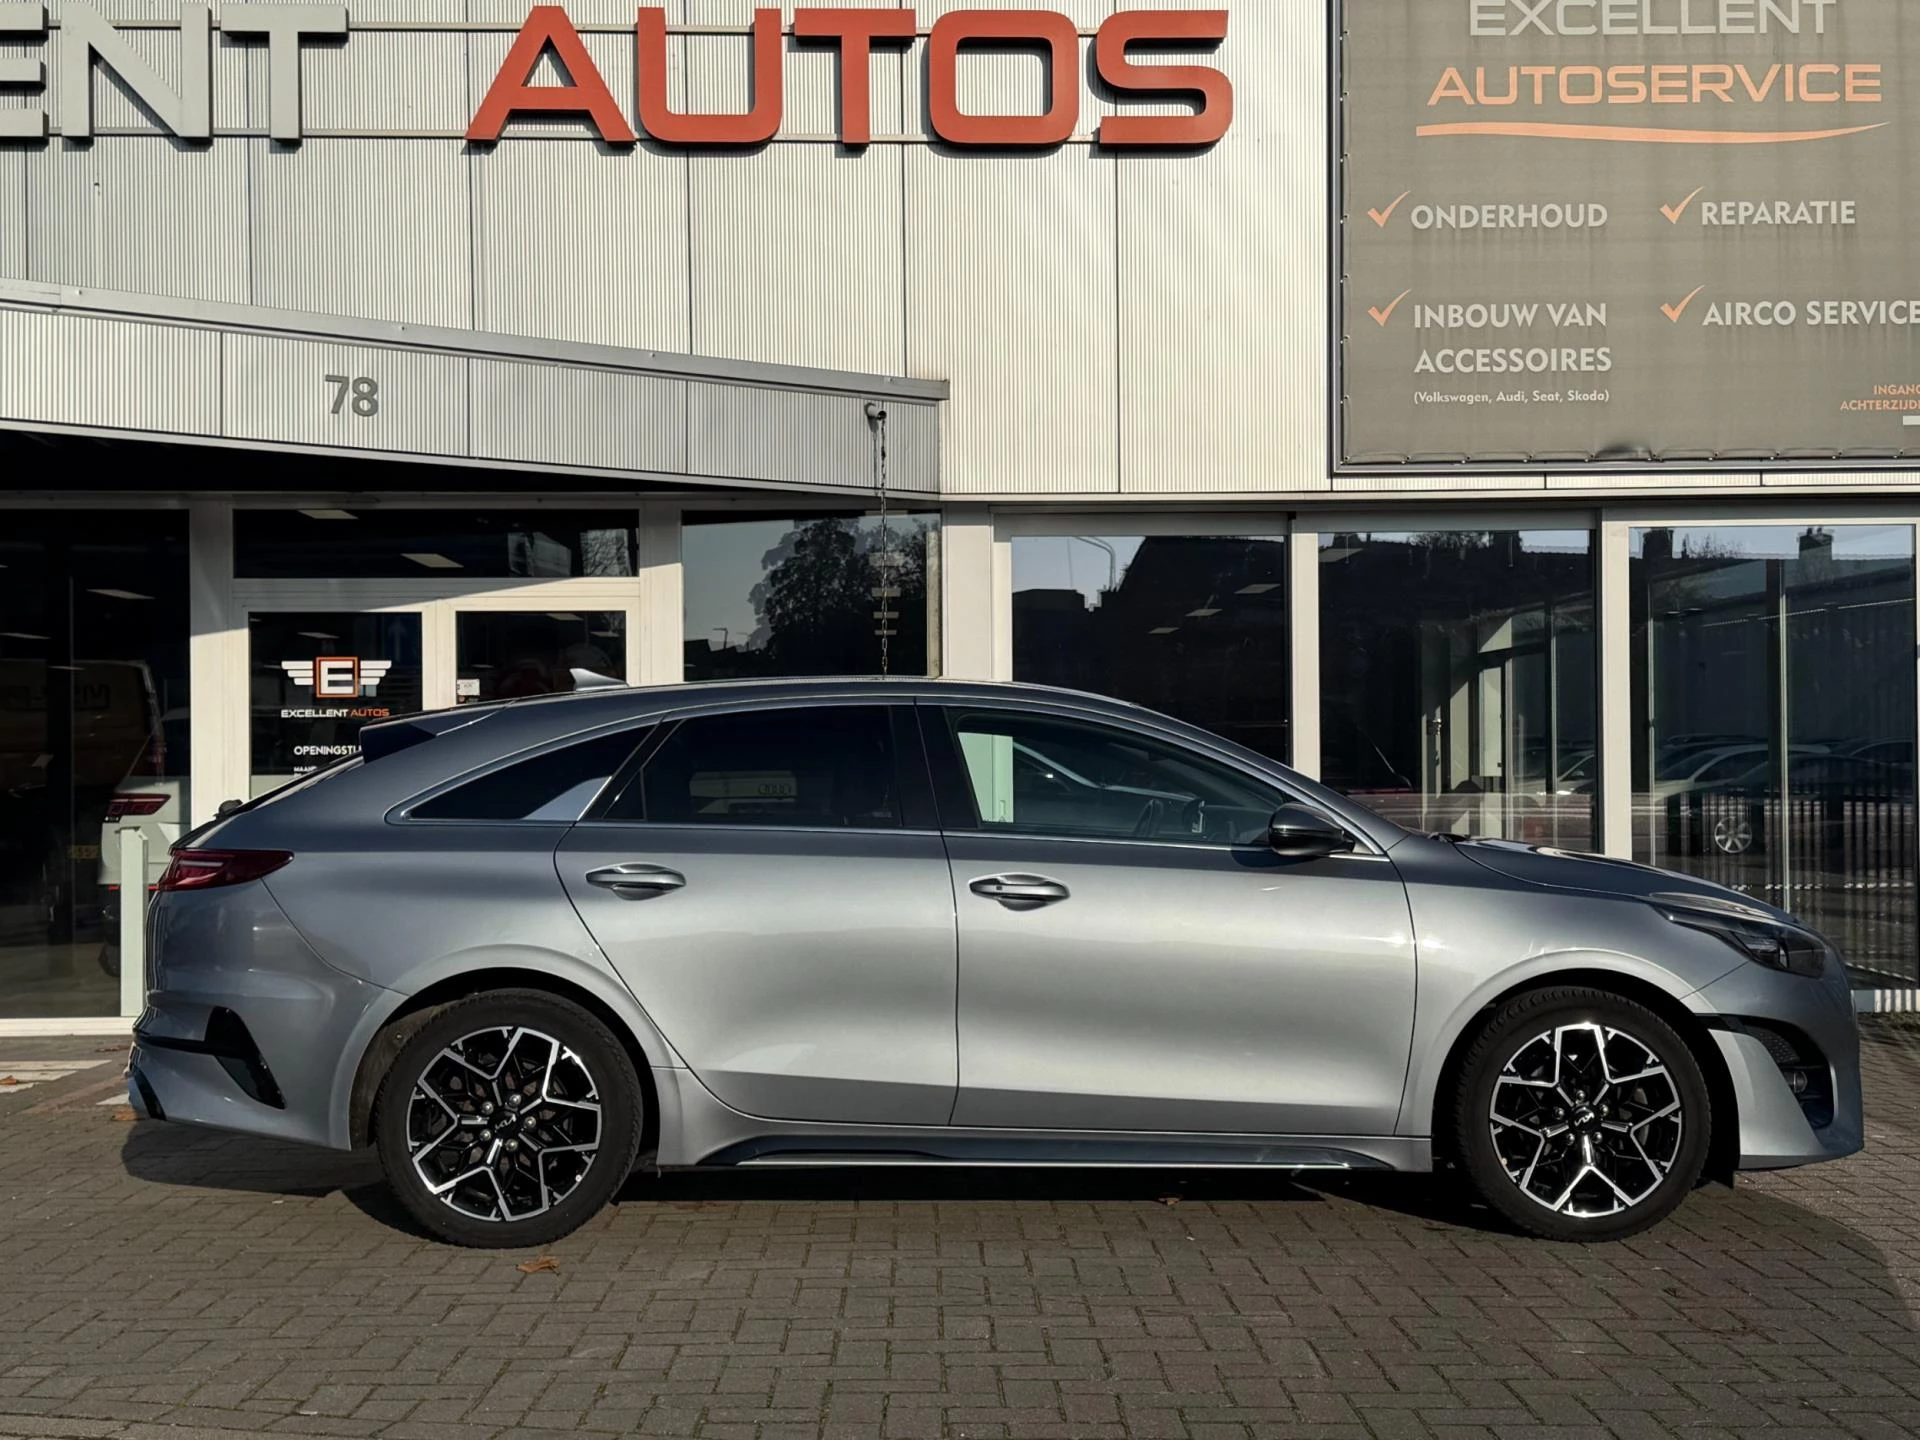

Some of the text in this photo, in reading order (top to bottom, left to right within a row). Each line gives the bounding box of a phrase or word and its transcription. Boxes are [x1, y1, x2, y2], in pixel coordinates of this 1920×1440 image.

[1469, 0, 1837, 36] EXCELLENT
[464, 5, 1234, 149] AUTOS
[1427, 63, 1882, 106] AUTOSERVICE
[1410, 203, 1608, 230] ONDERHOUD
[1701, 200, 1856, 226] REPARATIE
[1413, 302, 1607, 329] INBOUW VAN
[1702, 300, 1920, 326] AIRCO SERVICE
[1413, 346, 1613, 374] ACCESSOIRES
[324, 374, 379, 417] 78
[1413, 389, 1610, 405] (Volkswagen, Audi, Seat, Skoda)
[281, 707, 390, 719] EXCELLENT AUTOS
